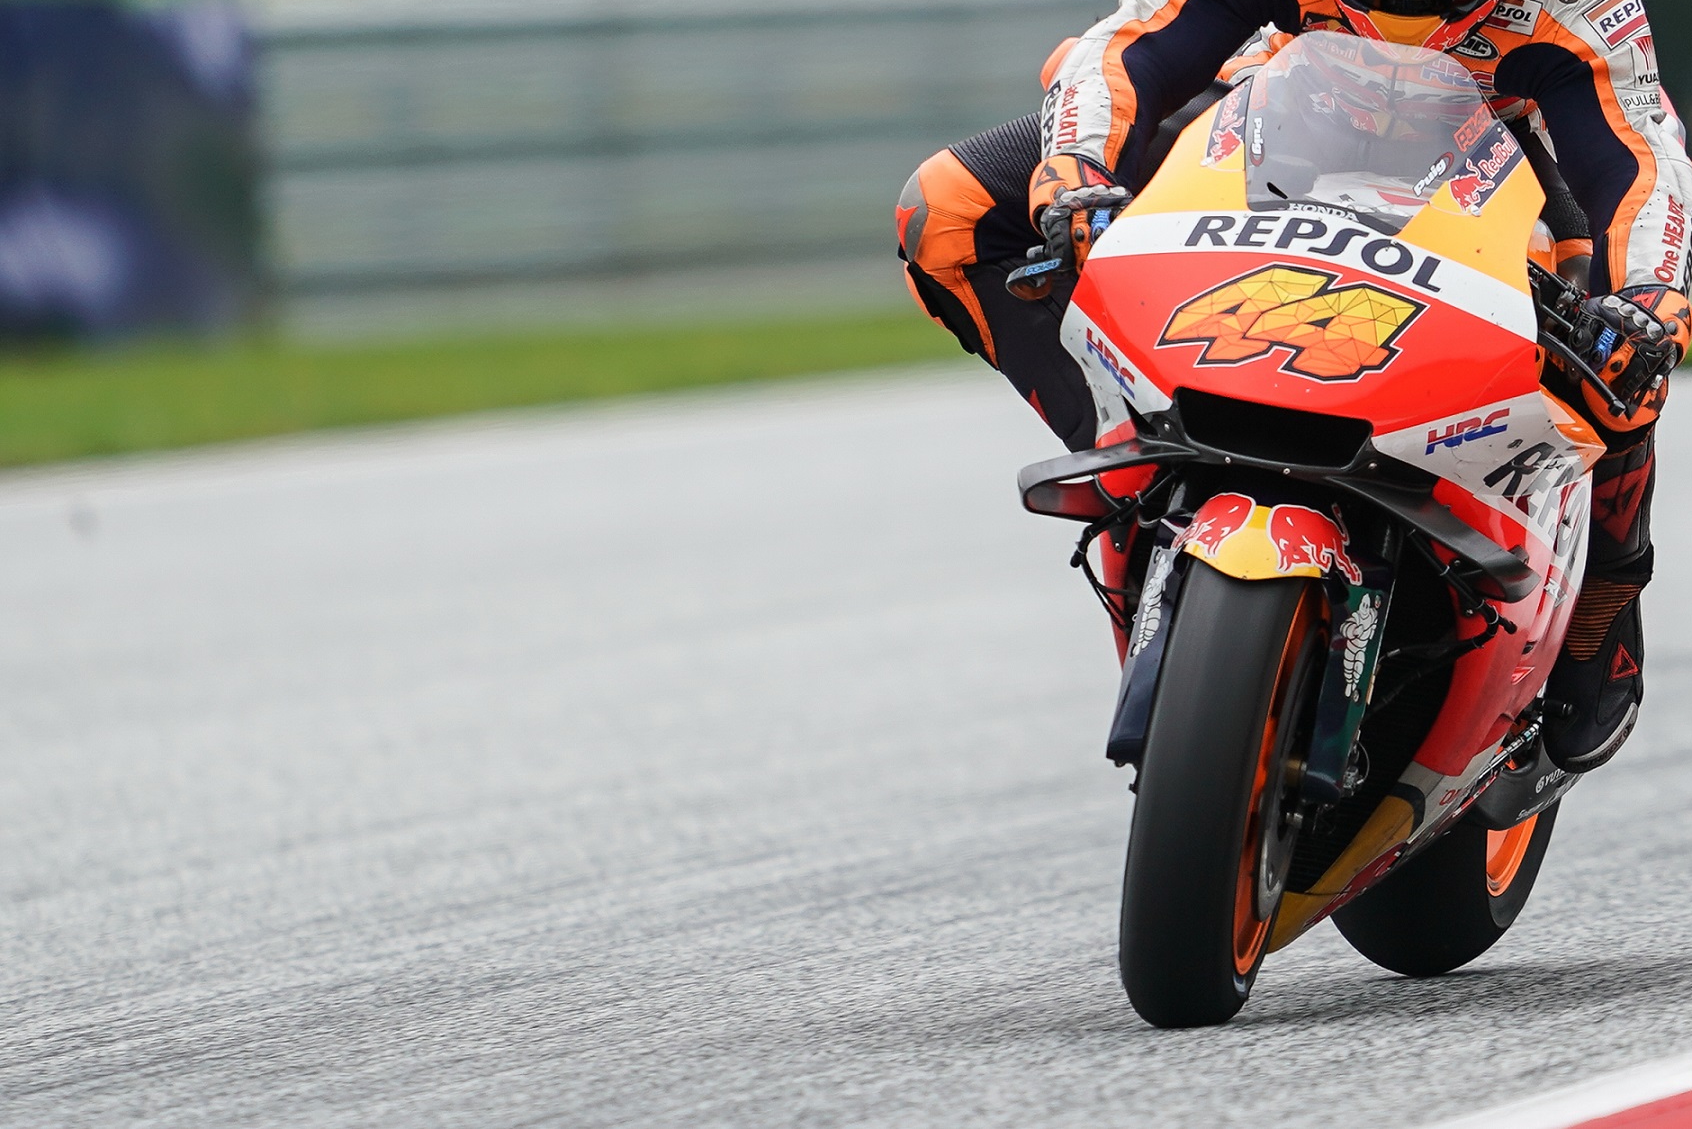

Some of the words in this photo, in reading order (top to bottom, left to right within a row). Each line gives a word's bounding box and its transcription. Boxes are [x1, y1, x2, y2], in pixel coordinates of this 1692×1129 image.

[1495, 5, 1532, 22] PSOL
[1638, 73, 1660, 85] YUA
[1624, 93, 1661, 107] PULL&B
[1413, 159, 1447, 197] Puig
[1288, 203, 1360, 222] HONDA
[1185, 215, 1441, 293] REPSOL
[1654, 250, 1679, 283] One
[1156, 263, 1428, 382] 44
[1425, 408, 1510, 455] HRC
